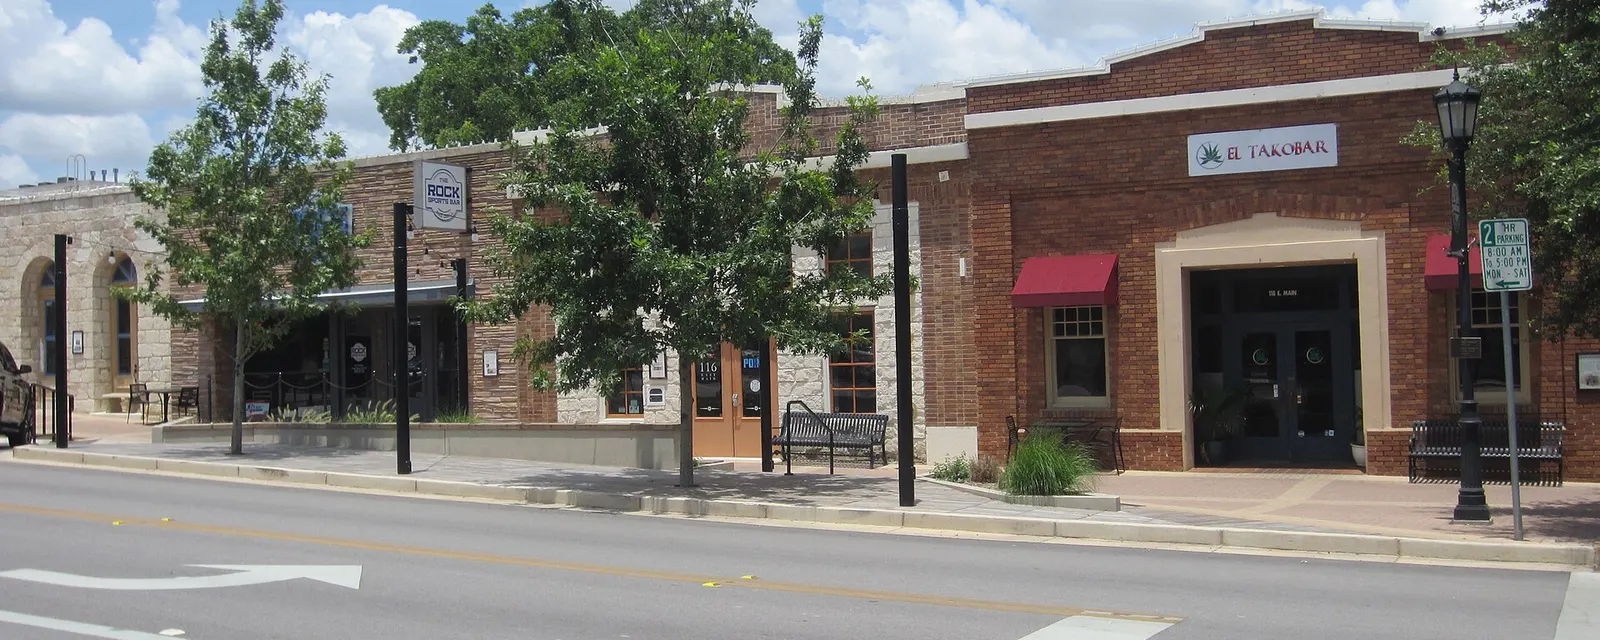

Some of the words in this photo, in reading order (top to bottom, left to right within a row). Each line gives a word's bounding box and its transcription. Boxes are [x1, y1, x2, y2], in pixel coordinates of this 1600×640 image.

[1227, 146, 1241, 160] EL
[1248, 140, 1329, 159] TAKOBAR
[427, 184, 460, 199] ROCK
[1503, 223, 1516, 232] HR
[1483, 223, 1493, 245] 2
[1497, 233, 1524, 244] PARKING
[1488, 247, 1506, 257] 8:00
[1511, 246, 1522, 256] AM
[1497, 257, 1513, 267] 5:00
[1517, 256, 1527, 266] PM
[1486, 269, 1504, 279] MON.
[1514, 267, 1527, 277] SAT
[700, 362, 717, 372] 116
